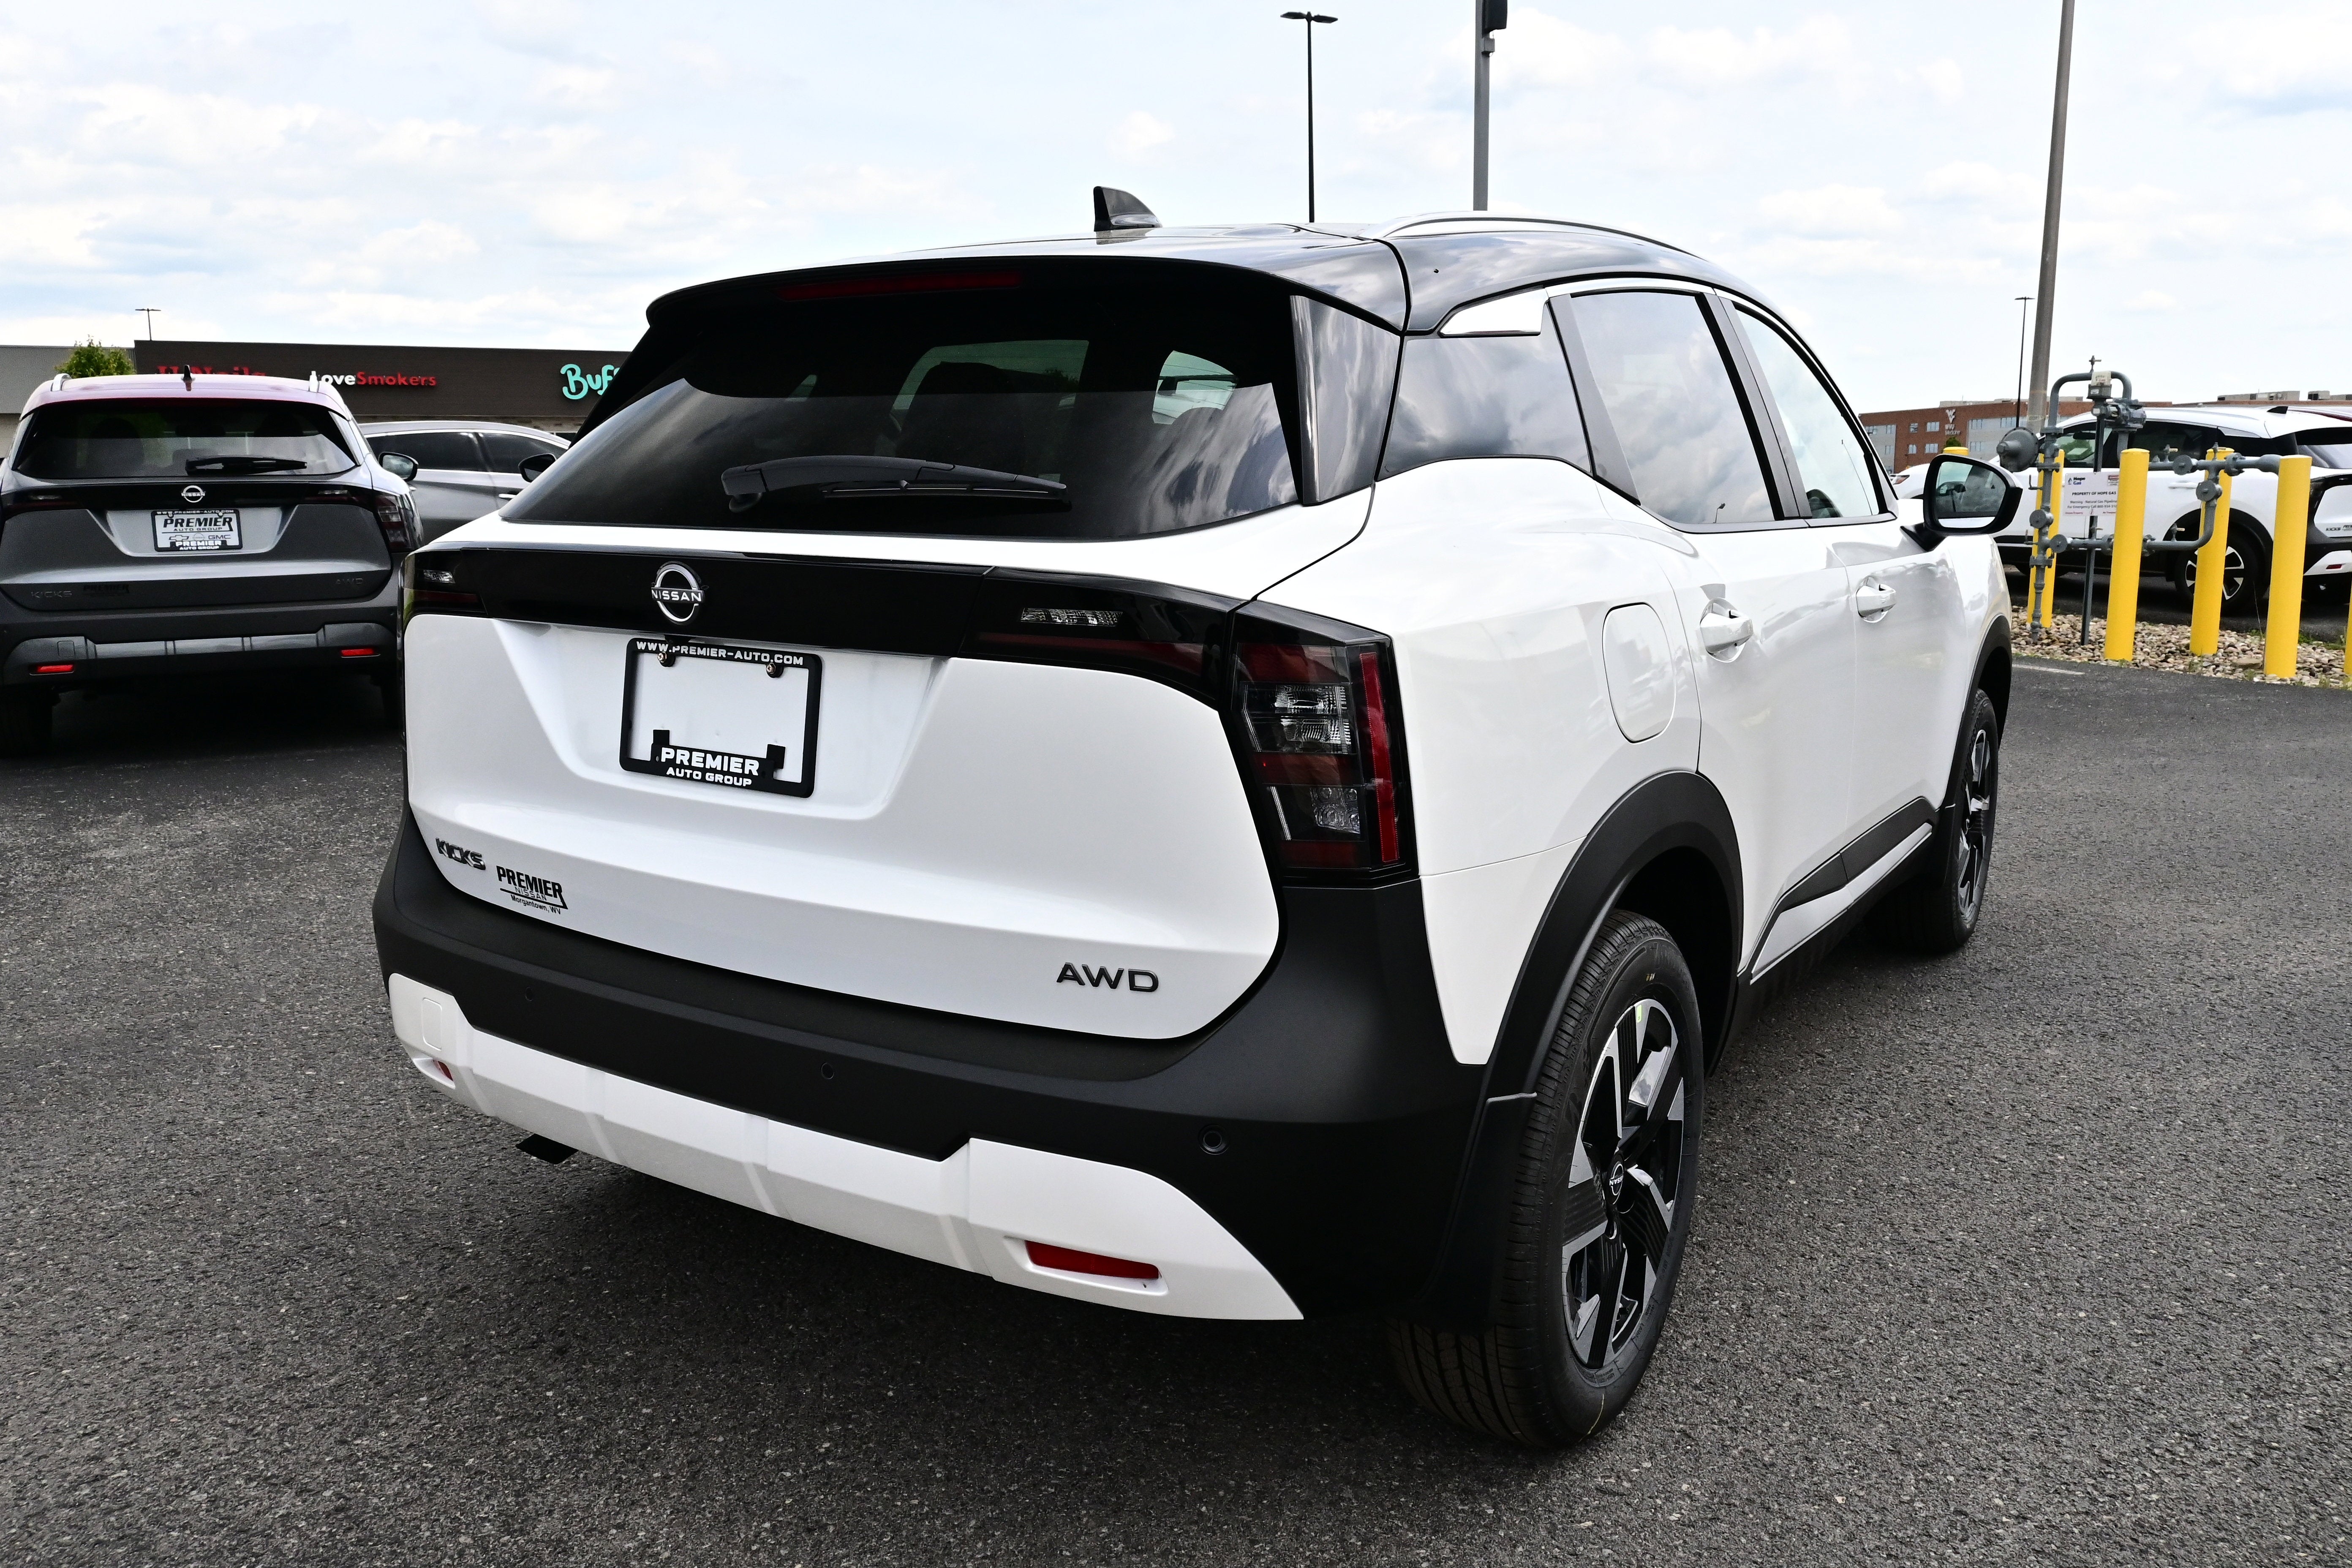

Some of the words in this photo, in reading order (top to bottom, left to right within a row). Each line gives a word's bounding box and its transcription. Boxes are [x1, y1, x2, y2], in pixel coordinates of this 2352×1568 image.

[560, 364, 620, 400] Buf
[163, 517, 234, 531] PREMIER
[31, 591, 72, 599] KICKS
[651, 589, 702, 602] NISSAN
[636, 641, 803, 666] WWW.PREMIER-AUTO.COM
[661, 746, 760, 776] PREMIER
[666, 766, 702, 781] AUTO
[705, 771, 752, 787] GROUP
[436, 837, 486, 871] KICKS
[496, 865, 569, 909] PREMIER
[514, 886, 547, 901] NISSAN
[550, 906, 561, 915] WV
[1056, 962, 1159, 992] AWD
